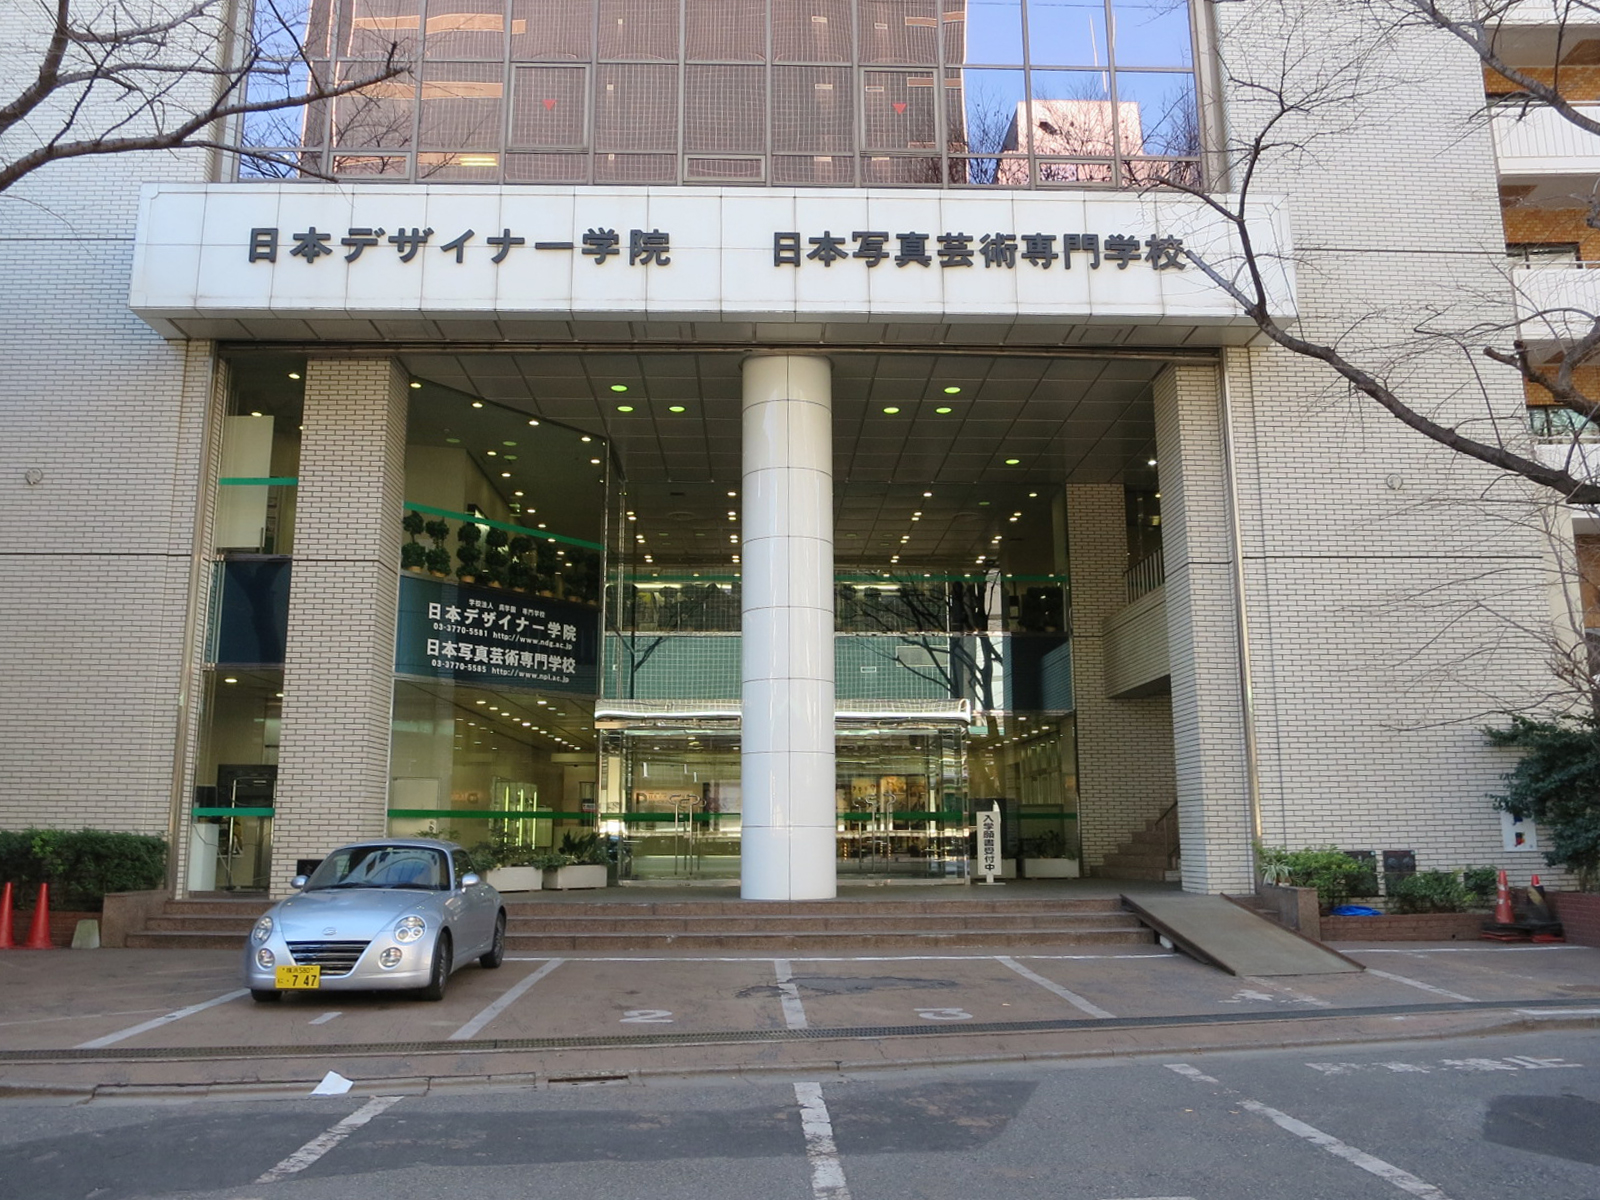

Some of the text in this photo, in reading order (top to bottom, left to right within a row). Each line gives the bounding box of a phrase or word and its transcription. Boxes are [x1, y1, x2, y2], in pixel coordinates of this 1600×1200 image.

[248, 226, 671, 266] 日本デザイナー学院
[773, 230, 1188, 271] 日本写真芸術専門学校
[428, 602, 577, 642] 日本デザイナー学院
[433, 622, 488, 638] 03-3770-5581
[426, 638, 576, 674] 日本写真芸術専門学校
[983, 814, 995, 872] 入学願書受付中
